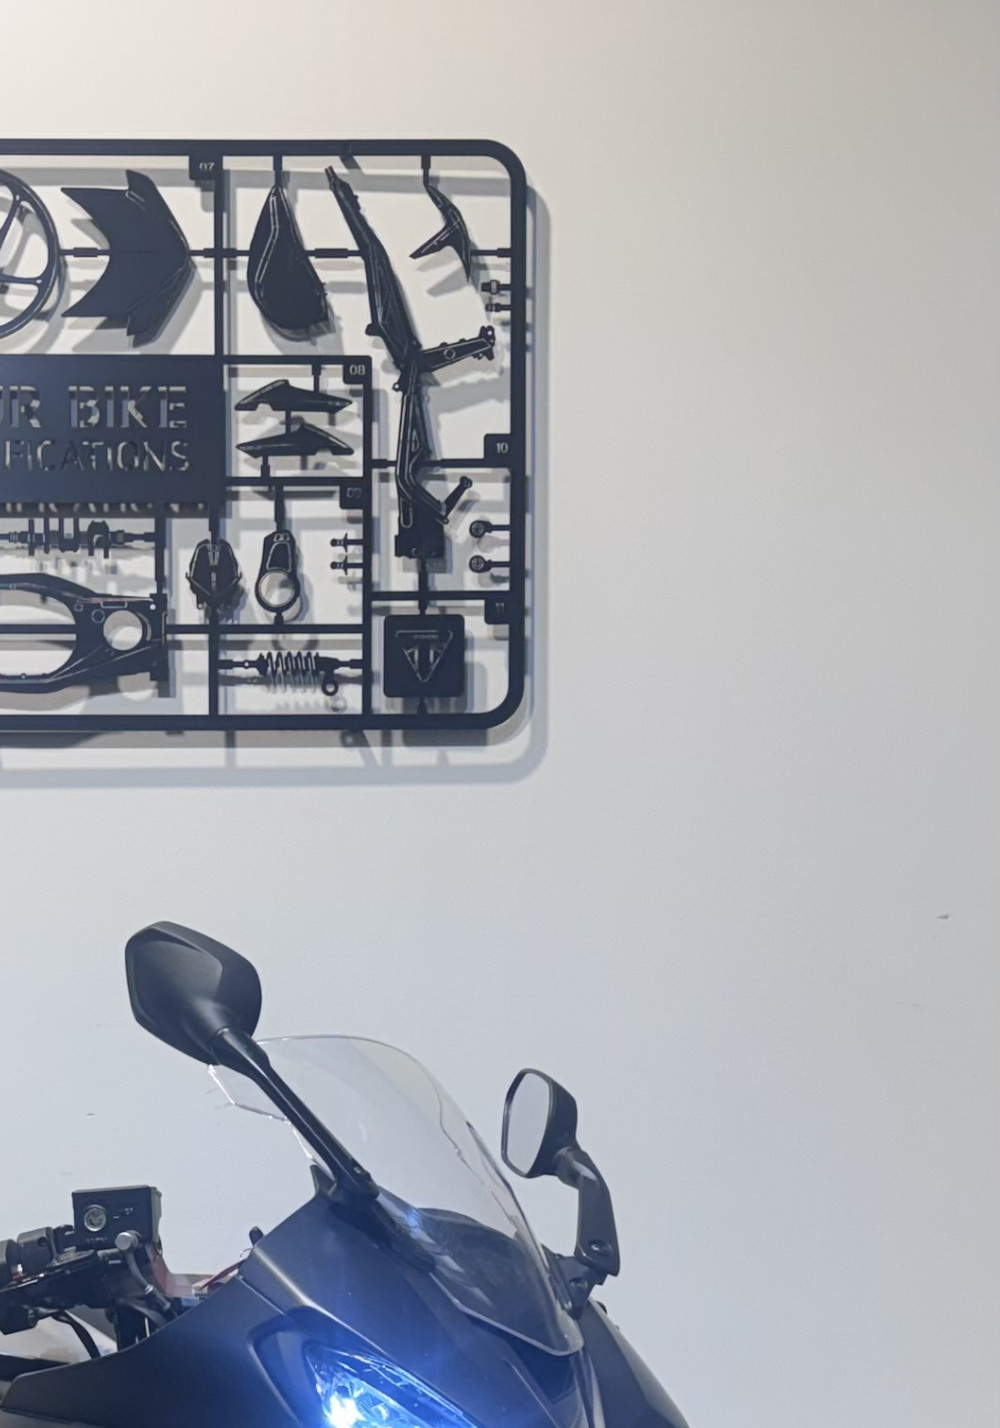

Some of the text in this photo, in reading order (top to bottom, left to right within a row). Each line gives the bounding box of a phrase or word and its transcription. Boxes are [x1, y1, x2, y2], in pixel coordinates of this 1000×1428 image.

[199, 162, 215, 171] 07
[349, 364, 366, 375] 08
[67, 385, 187, 429] BIKE
[495, 442, 508, 454] 10
